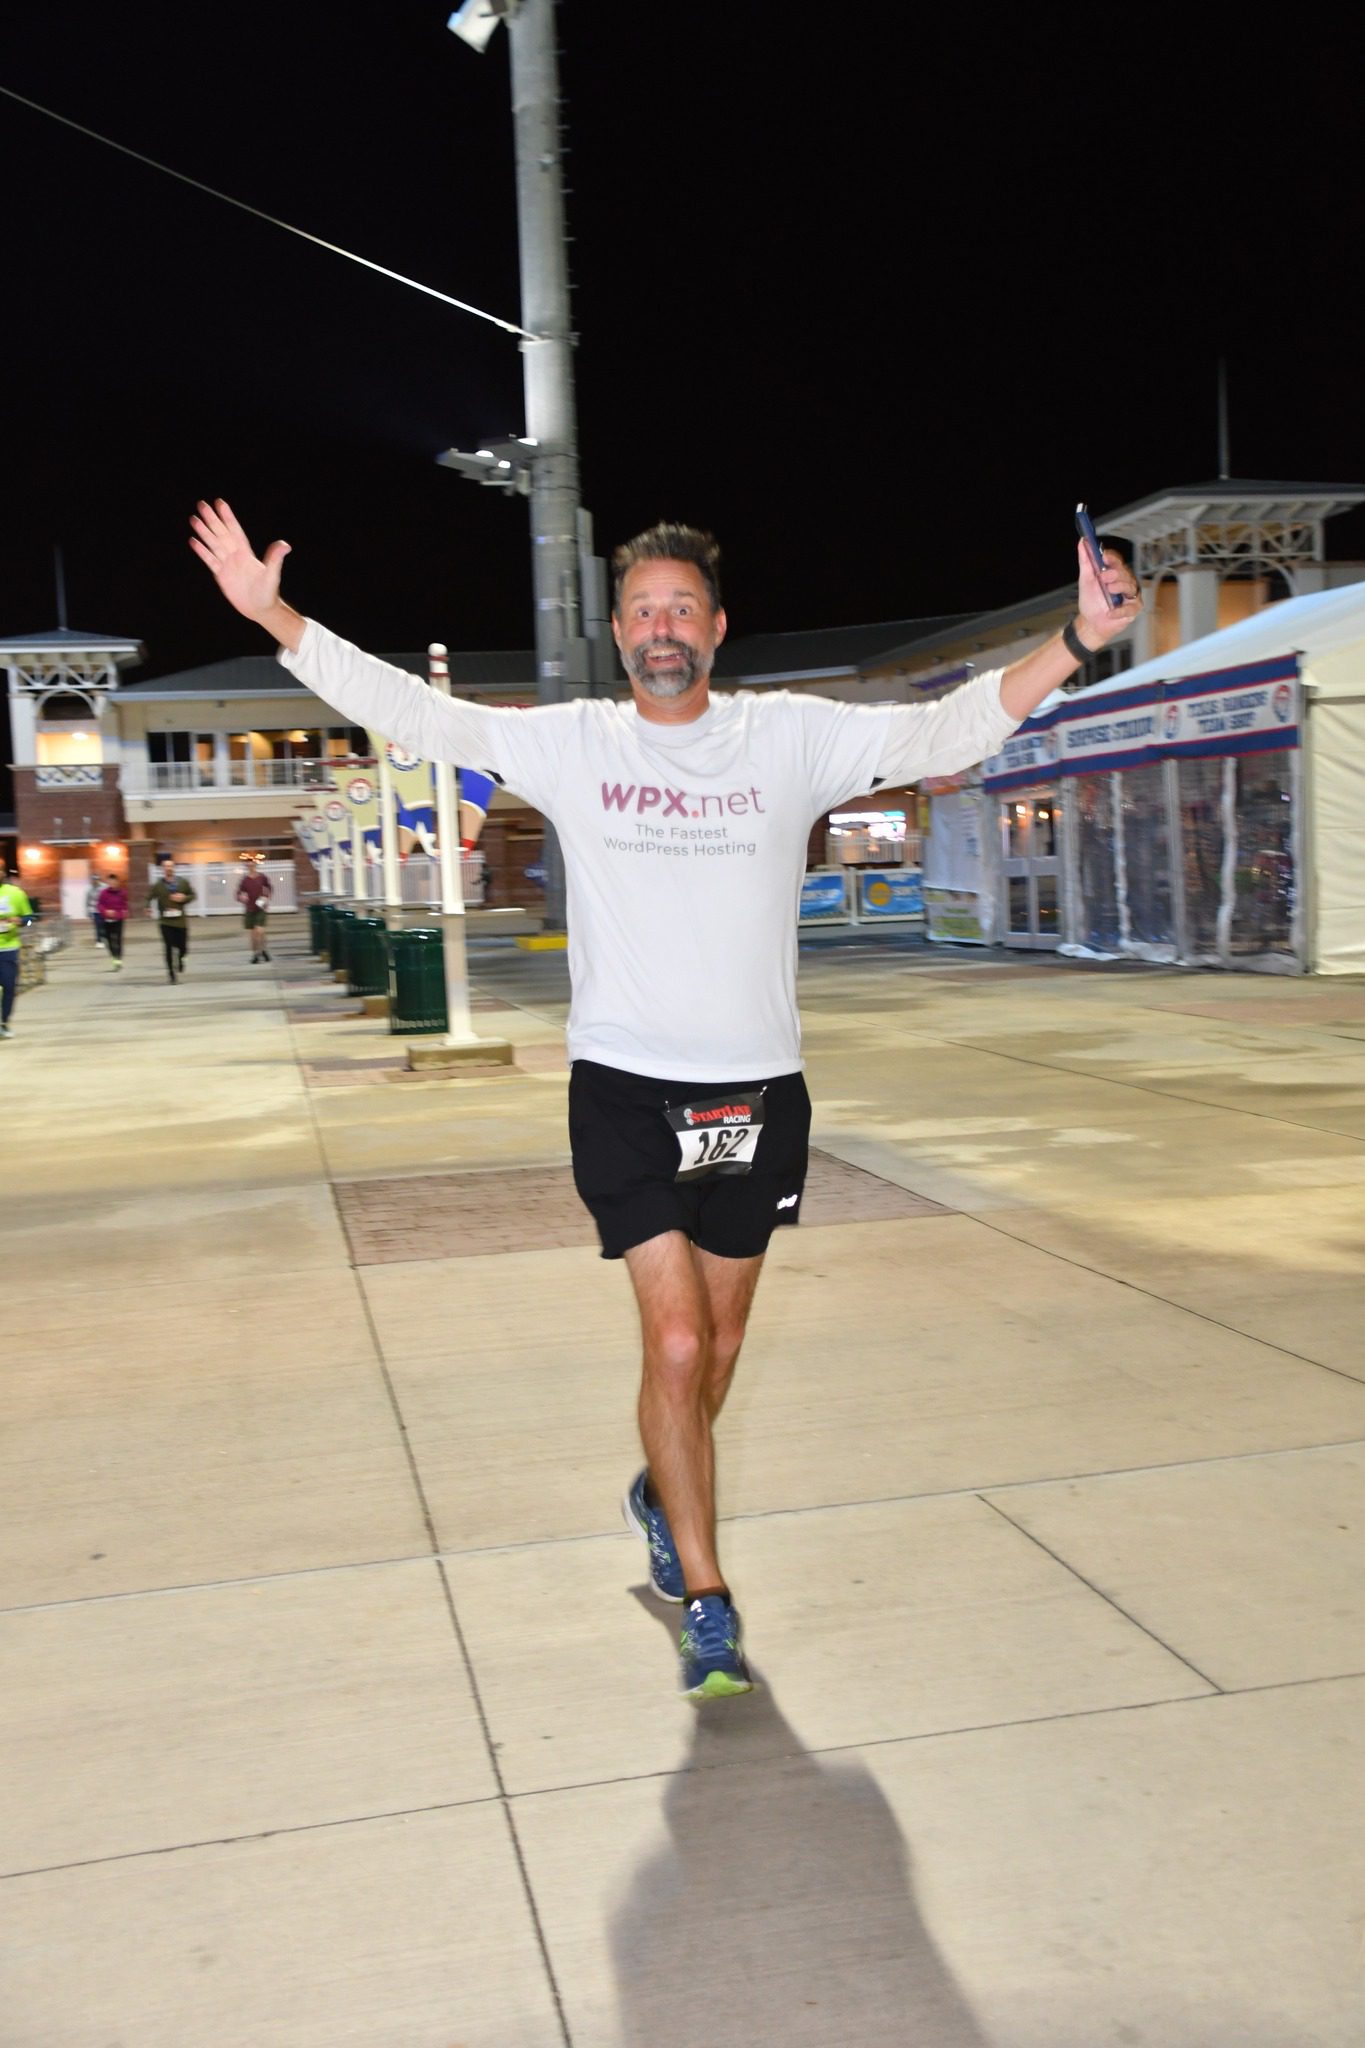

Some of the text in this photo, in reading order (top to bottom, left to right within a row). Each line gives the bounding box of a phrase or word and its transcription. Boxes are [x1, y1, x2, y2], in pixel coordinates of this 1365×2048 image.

[601, 782, 766, 819] WPX.net
[635, 823, 728, 840] The Fastest
[603, 837, 757, 856] WordPress Hosting
[723, 1115, 752, 1124] RACING
[694, 1128, 749, 1166] 162
